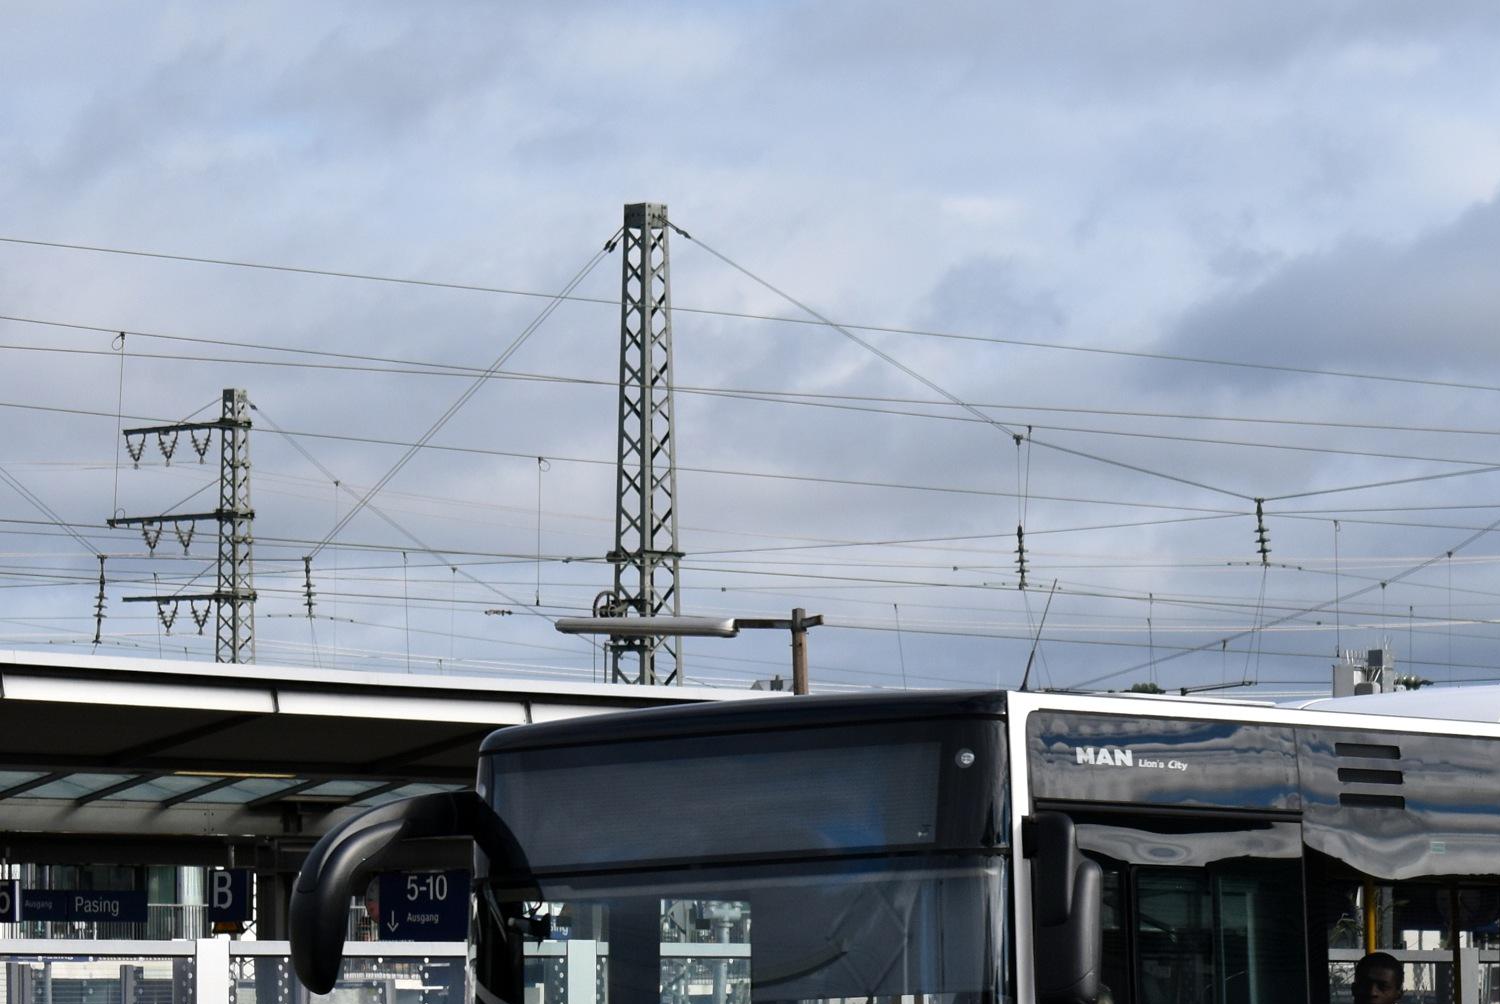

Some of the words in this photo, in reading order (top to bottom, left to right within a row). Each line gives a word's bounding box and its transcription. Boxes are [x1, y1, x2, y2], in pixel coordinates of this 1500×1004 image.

[1075, 746, 1134, 767] MAN
[1138, 758, 1165, 769] Lion's
[1167, 760, 1188, 771] City
[213, 871, 233, 909] B
[407, 875, 448, 900] 5-10
[75, 896, 120, 917] Pasing
[406, 912, 439, 925] Ausgang
